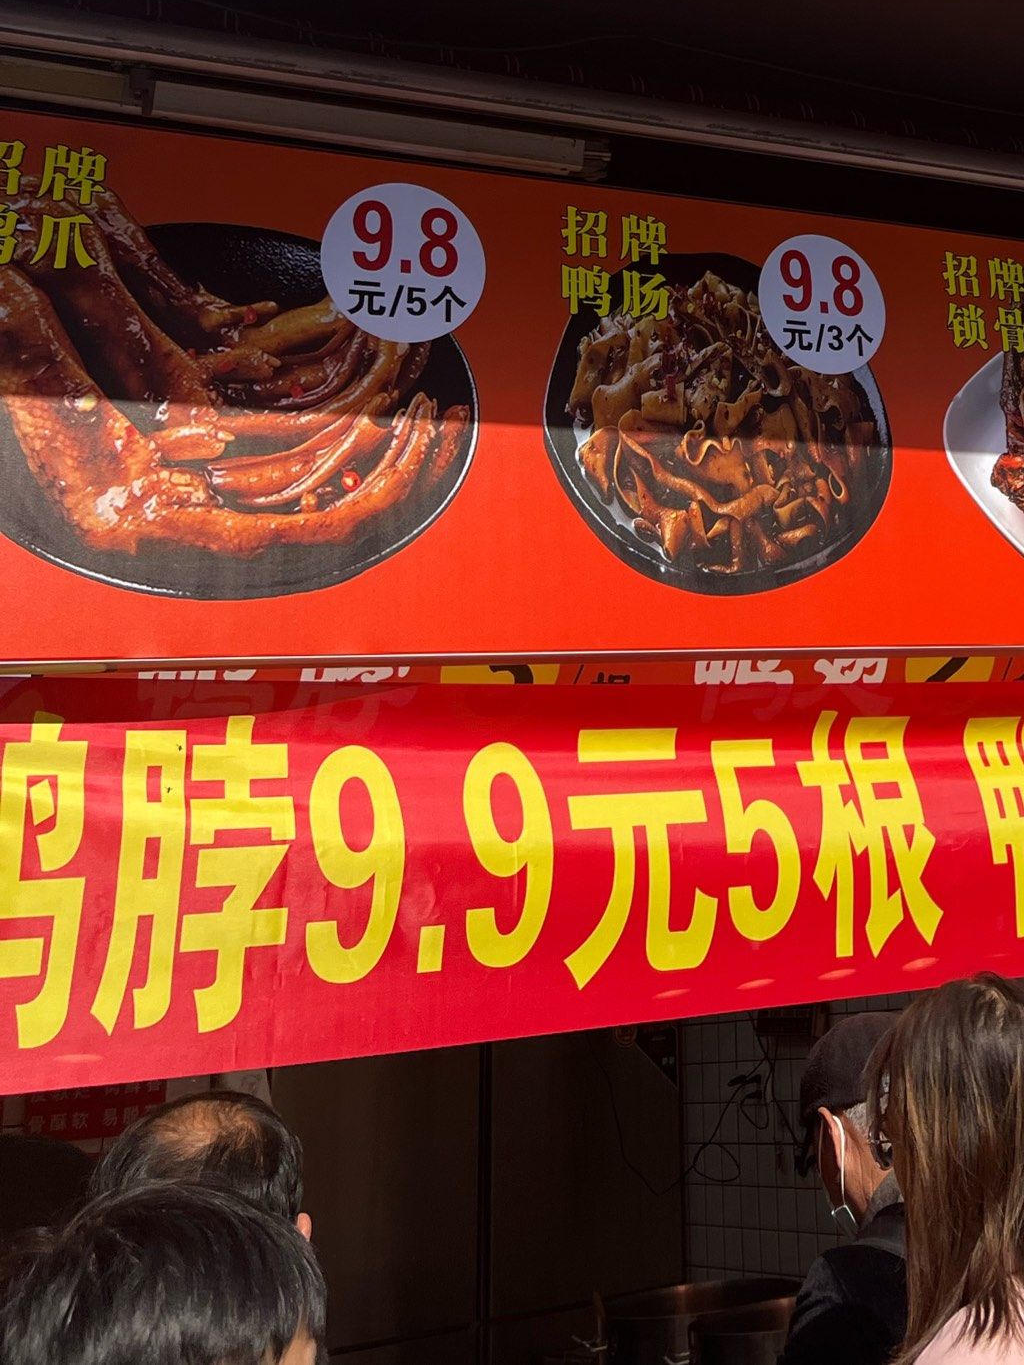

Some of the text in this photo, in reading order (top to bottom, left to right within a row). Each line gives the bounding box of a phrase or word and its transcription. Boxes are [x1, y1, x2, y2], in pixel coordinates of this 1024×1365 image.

[352, 200, 459, 277] 9.8
[560, 206, 669, 266] 招牌
[347, 280, 468, 324] 元/5个
[560, 265, 671, 320] 鸭肠
[779, 248, 865, 317] 9.8
[782, 321, 873, 357] 元/3个
